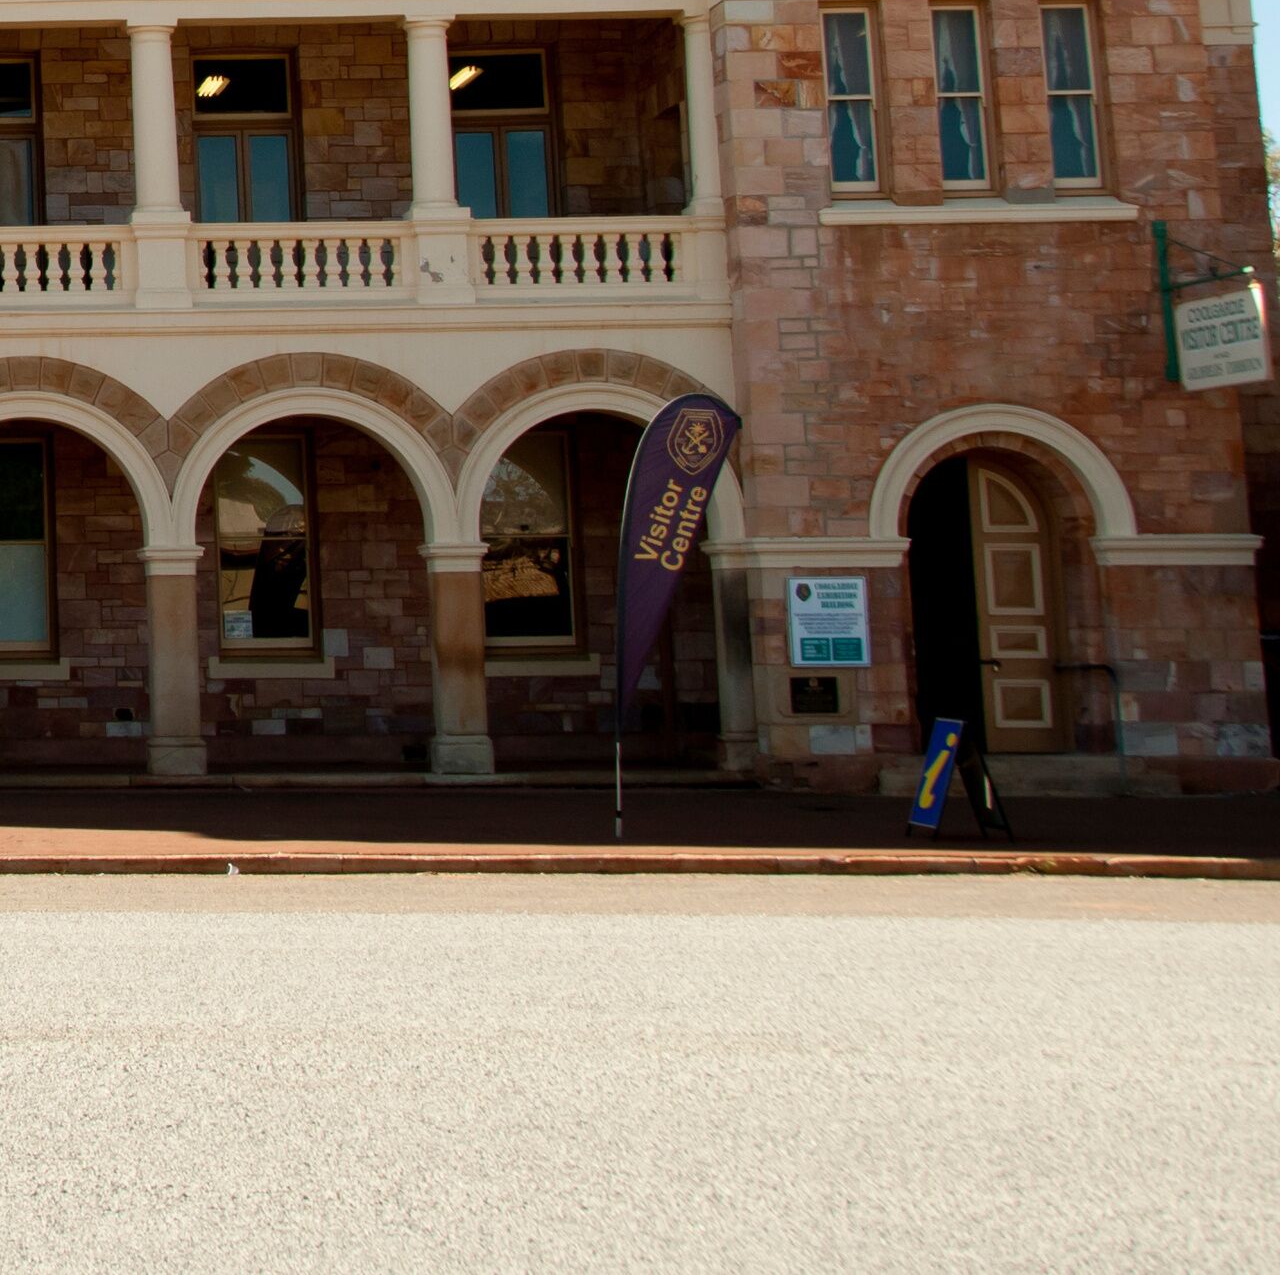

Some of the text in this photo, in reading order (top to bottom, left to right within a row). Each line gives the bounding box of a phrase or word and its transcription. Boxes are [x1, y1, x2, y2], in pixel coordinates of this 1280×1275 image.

[633, 478, 684, 560] Visitor
[661, 486, 708, 571] Centre
[918, 732, 958, 809] i
